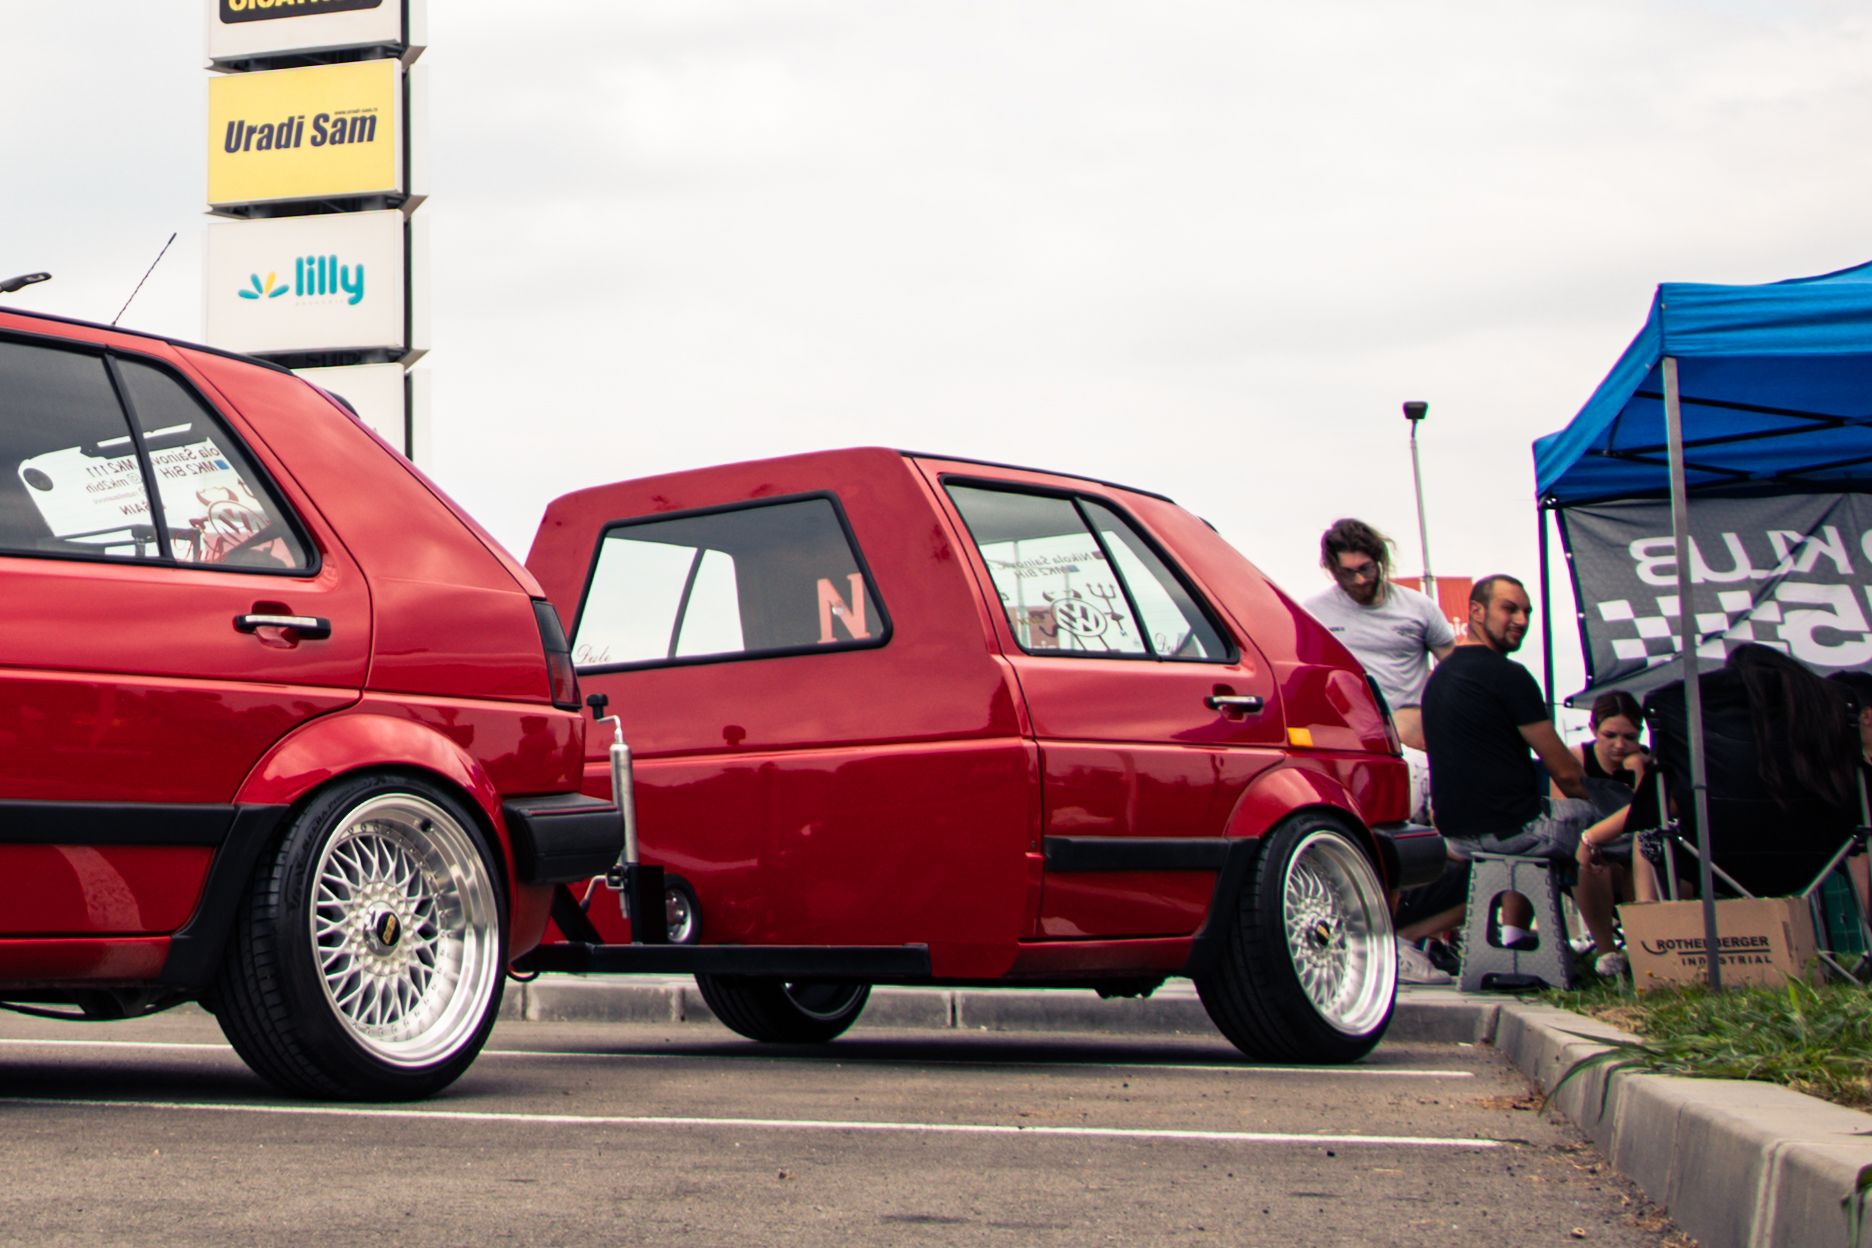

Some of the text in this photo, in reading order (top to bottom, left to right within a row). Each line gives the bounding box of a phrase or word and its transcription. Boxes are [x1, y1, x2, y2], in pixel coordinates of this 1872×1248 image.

[224, 113, 378, 153] Uradi Sam
[296, 254, 365, 305] lilly
[1656, 936, 1770, 950] ROTHEBERGER
[1682, 955, 1773, 966] INDSTRIAL
